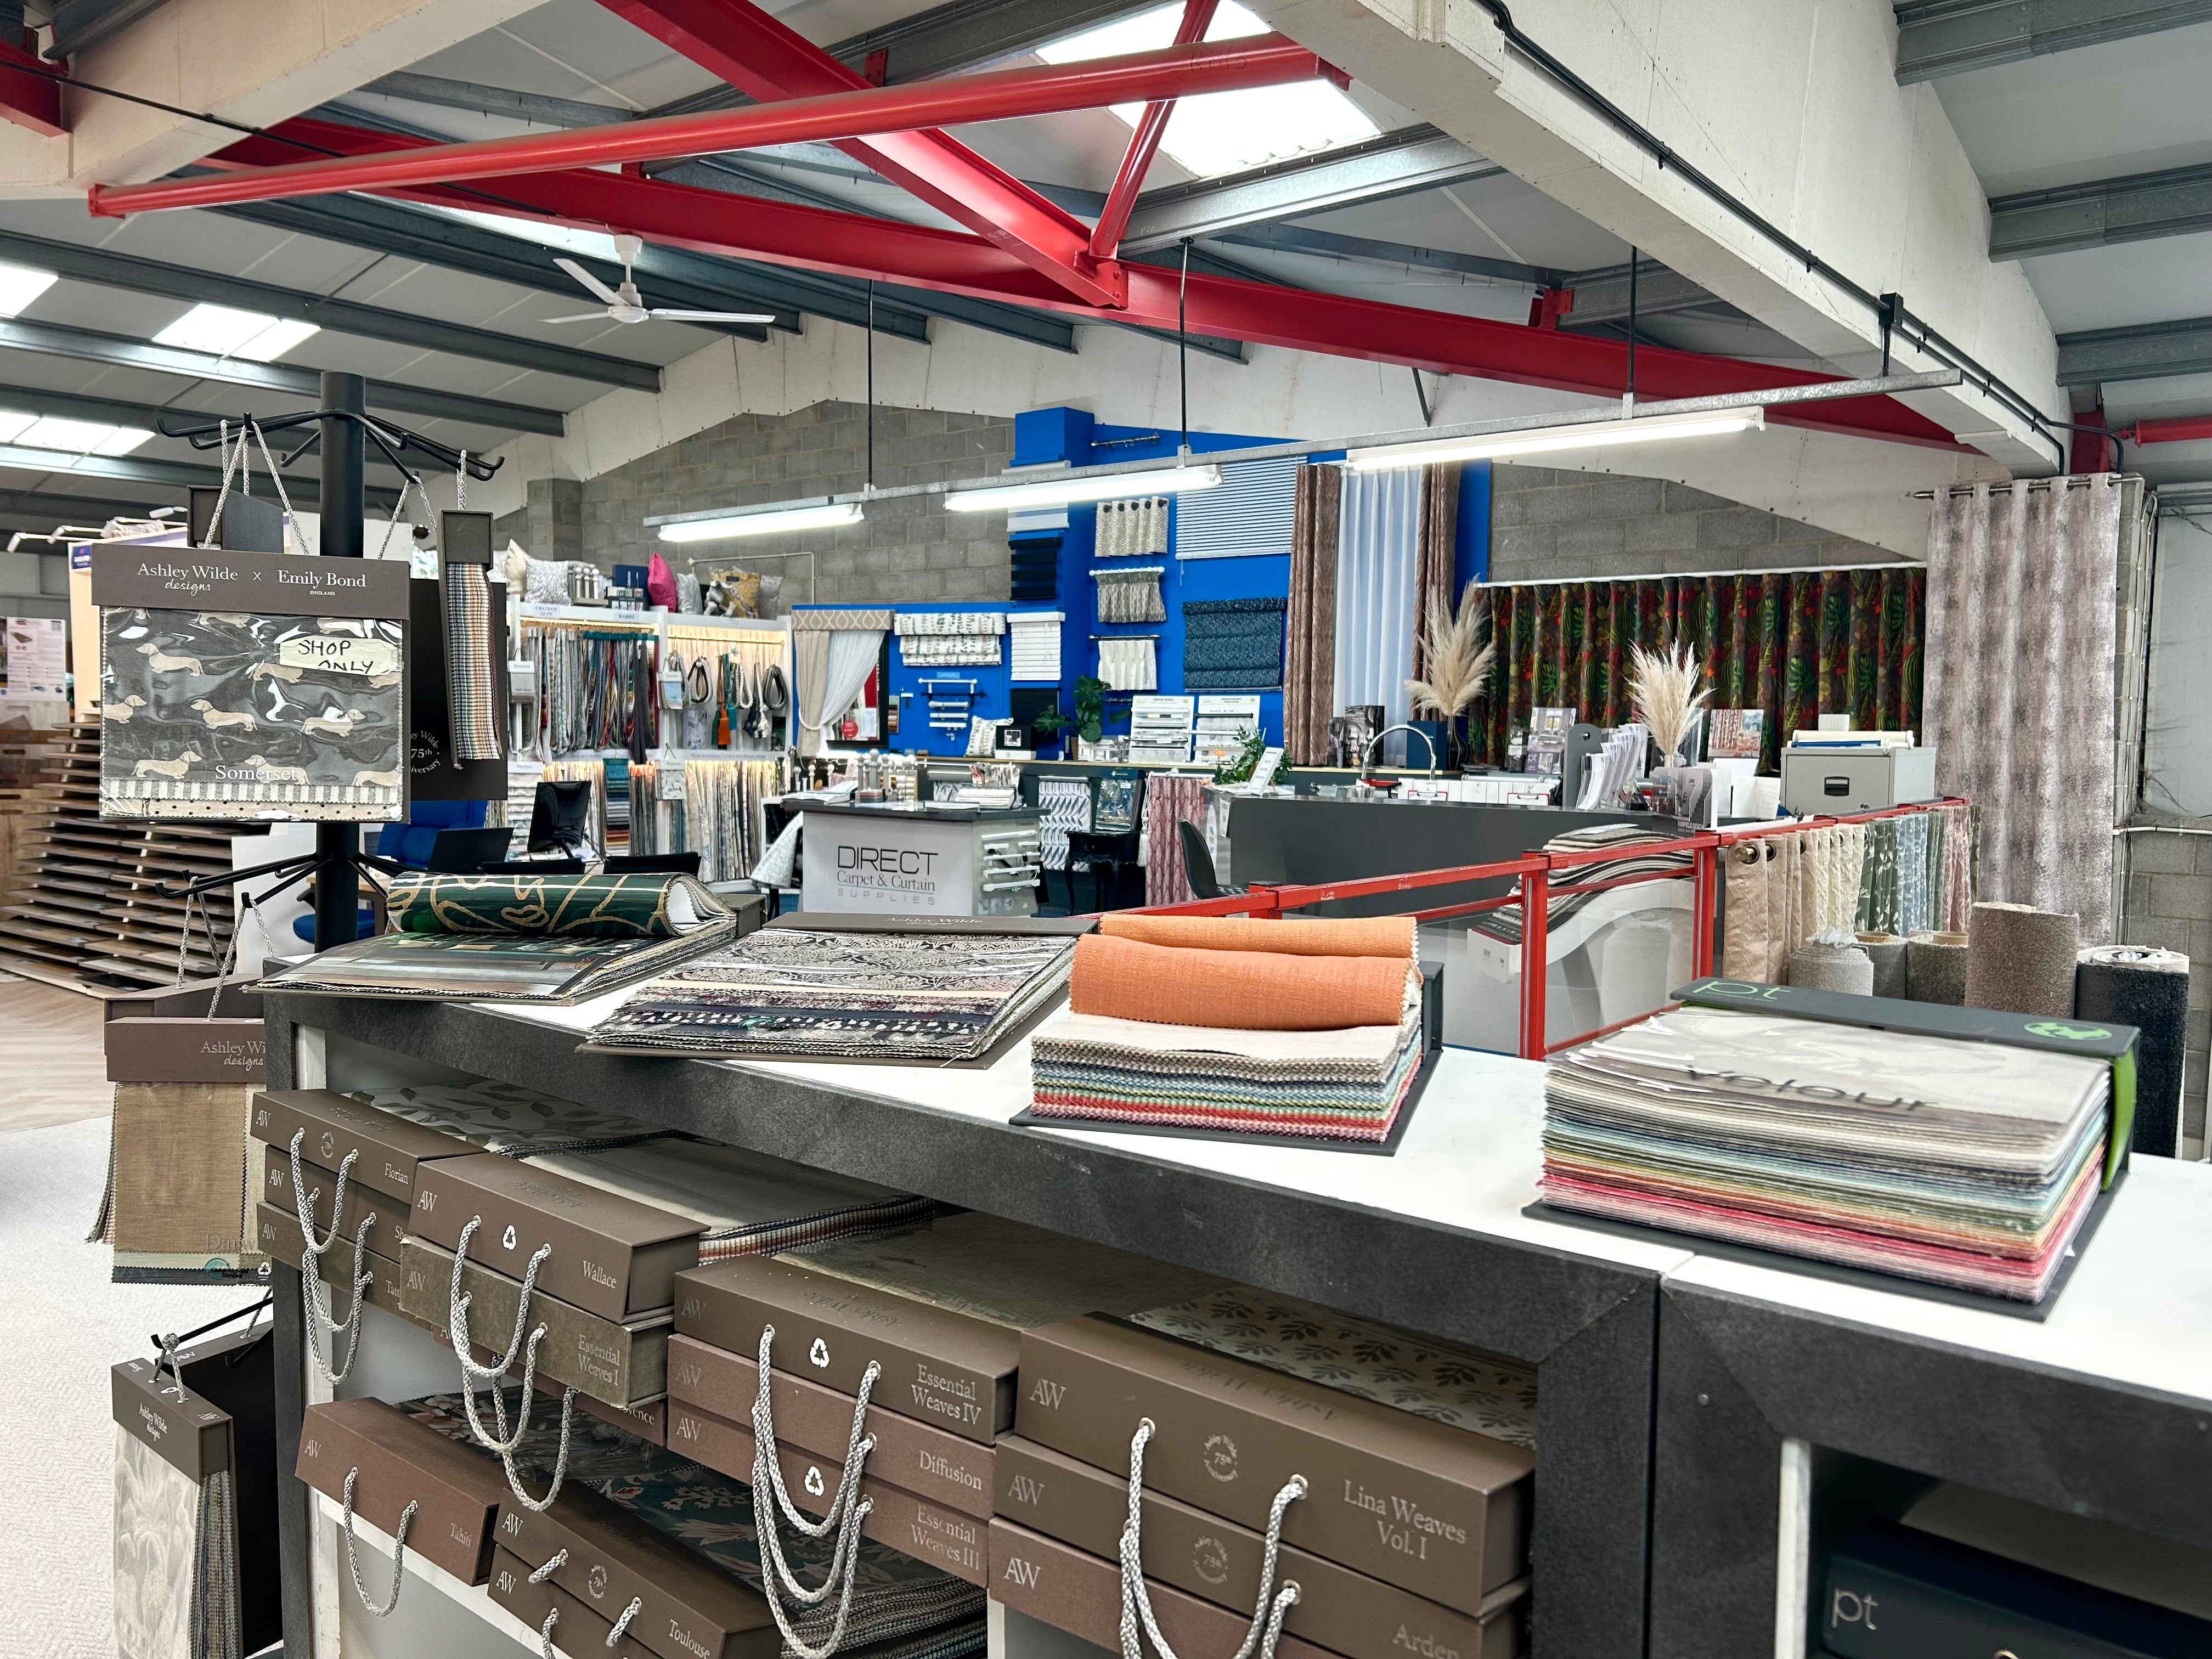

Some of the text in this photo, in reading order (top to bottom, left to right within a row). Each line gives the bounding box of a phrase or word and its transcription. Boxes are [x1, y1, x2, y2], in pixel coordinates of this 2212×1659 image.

[137, 562, 188, 580] Ashley
[192, 565, 238, 580] Wilde
[277, 569, 322, 588] Emily
[325, 573, 366, 588] Bond
[165, 579, 211, 596] designs
[298, 640, 351, 656] SHOP
[318, 660, 374, 673] ONLY
[421, 730, 439, 749] Wilde
[410, 748, 433, 759] 75th
[215, 765, 297, 781] Somerset
[410, 758, 441, 774] iversary
[838, 846, 938, 876] DIRECT
[837, 870, 935, 891] Carpet & Curtain
[838, 888, 935, 905] SUPPLIES
[1692, 981, 1791, 1000] pt
[200, 1040, 245, 1056] Ashley
[224, 1054, 263, 1071] designs
[256, 1110, 270, 1127] AW
[269, 1169, 285, 1187] AW
[385, 1163, 408, 1184] Florian
[417, 1190, 437, 1212] AW
[262, 1223, 276, 1241] AW
[407, 1271, 426, 1291] AW
[583, 1260, 617, 1289] Wallace
[681, 1296, 708, 1322] AW
[578, 1334, 620, 1366] Essential
[578, 1353, 619, 1386] Weaves I
[675, 1362, 702, 1387] AW
[917, 1363, 976, 1401] Essential
[1029, 1378, 1066, 1410] AW
[624, 1407, 654, 1425] ovence
[911, 1384, 981, 1425] Weaves IV
[676, 1417, 701, 1441] AW
[304, 1439, 321, 1459] AW
[919, 1450, 982, 1491] Diffusion
[1008, 1474, 1045, 1506] AW
[1344, 1479, 1466, 1544] Lina Weaves
[450, 1522, 472, 1547] Tahiti
[502, 1512, 523, 1537] AW
[918, 1505, 975, 1545] Essential
[911, 1523, 979, 1571] Weaves III
[1377, 1519, 1426, 1560] Vol. I
[496, 1570, 517, 1594] AW
[1004, 1556, 1041, 1589] AW
[1831, 1587, 1878, 1630] pt
[669, 1618, 710, 1659] Toulouse
